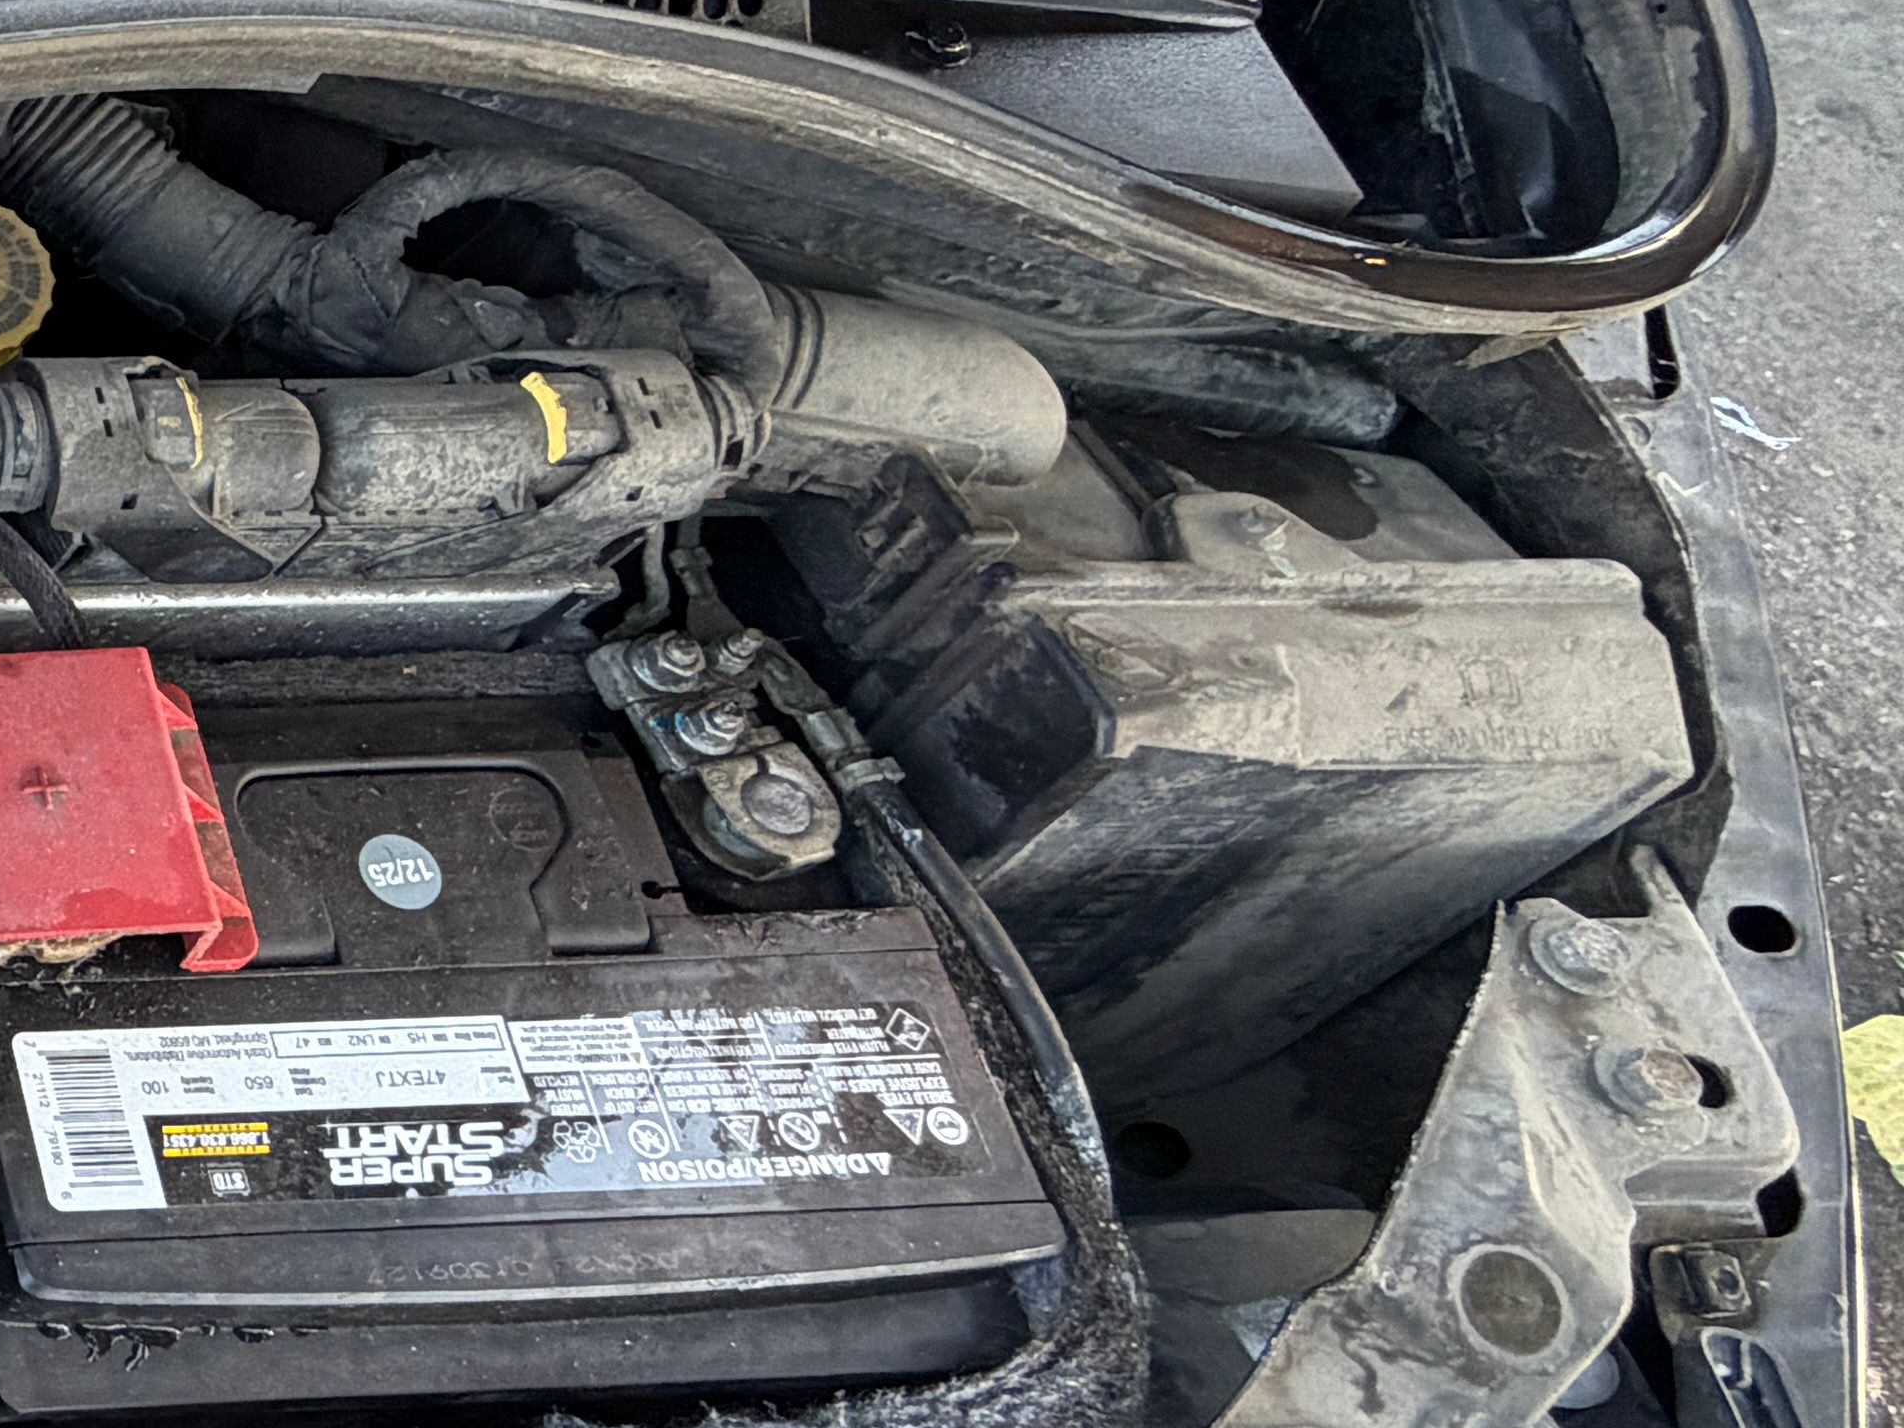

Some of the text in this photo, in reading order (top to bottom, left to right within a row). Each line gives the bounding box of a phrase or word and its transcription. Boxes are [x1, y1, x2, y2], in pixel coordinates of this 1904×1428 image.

[367, 858, 435, 888] 12/25
[295, 1037, 311, 1048] 47
[347, 1034, 375, 1047] LN2
[244, 1076, 274, 1090] 650
[375, 1070, 446, 1087] 47EXTJ
[141, 1080, 171, 1095] 100
[319, 1121, 504, 1158] START
[329, 1154, 493, 1186] SUPER
[637, 1153, 869, 1182] DANGER/POISON
[212, 1172, 245, 1190] STD
